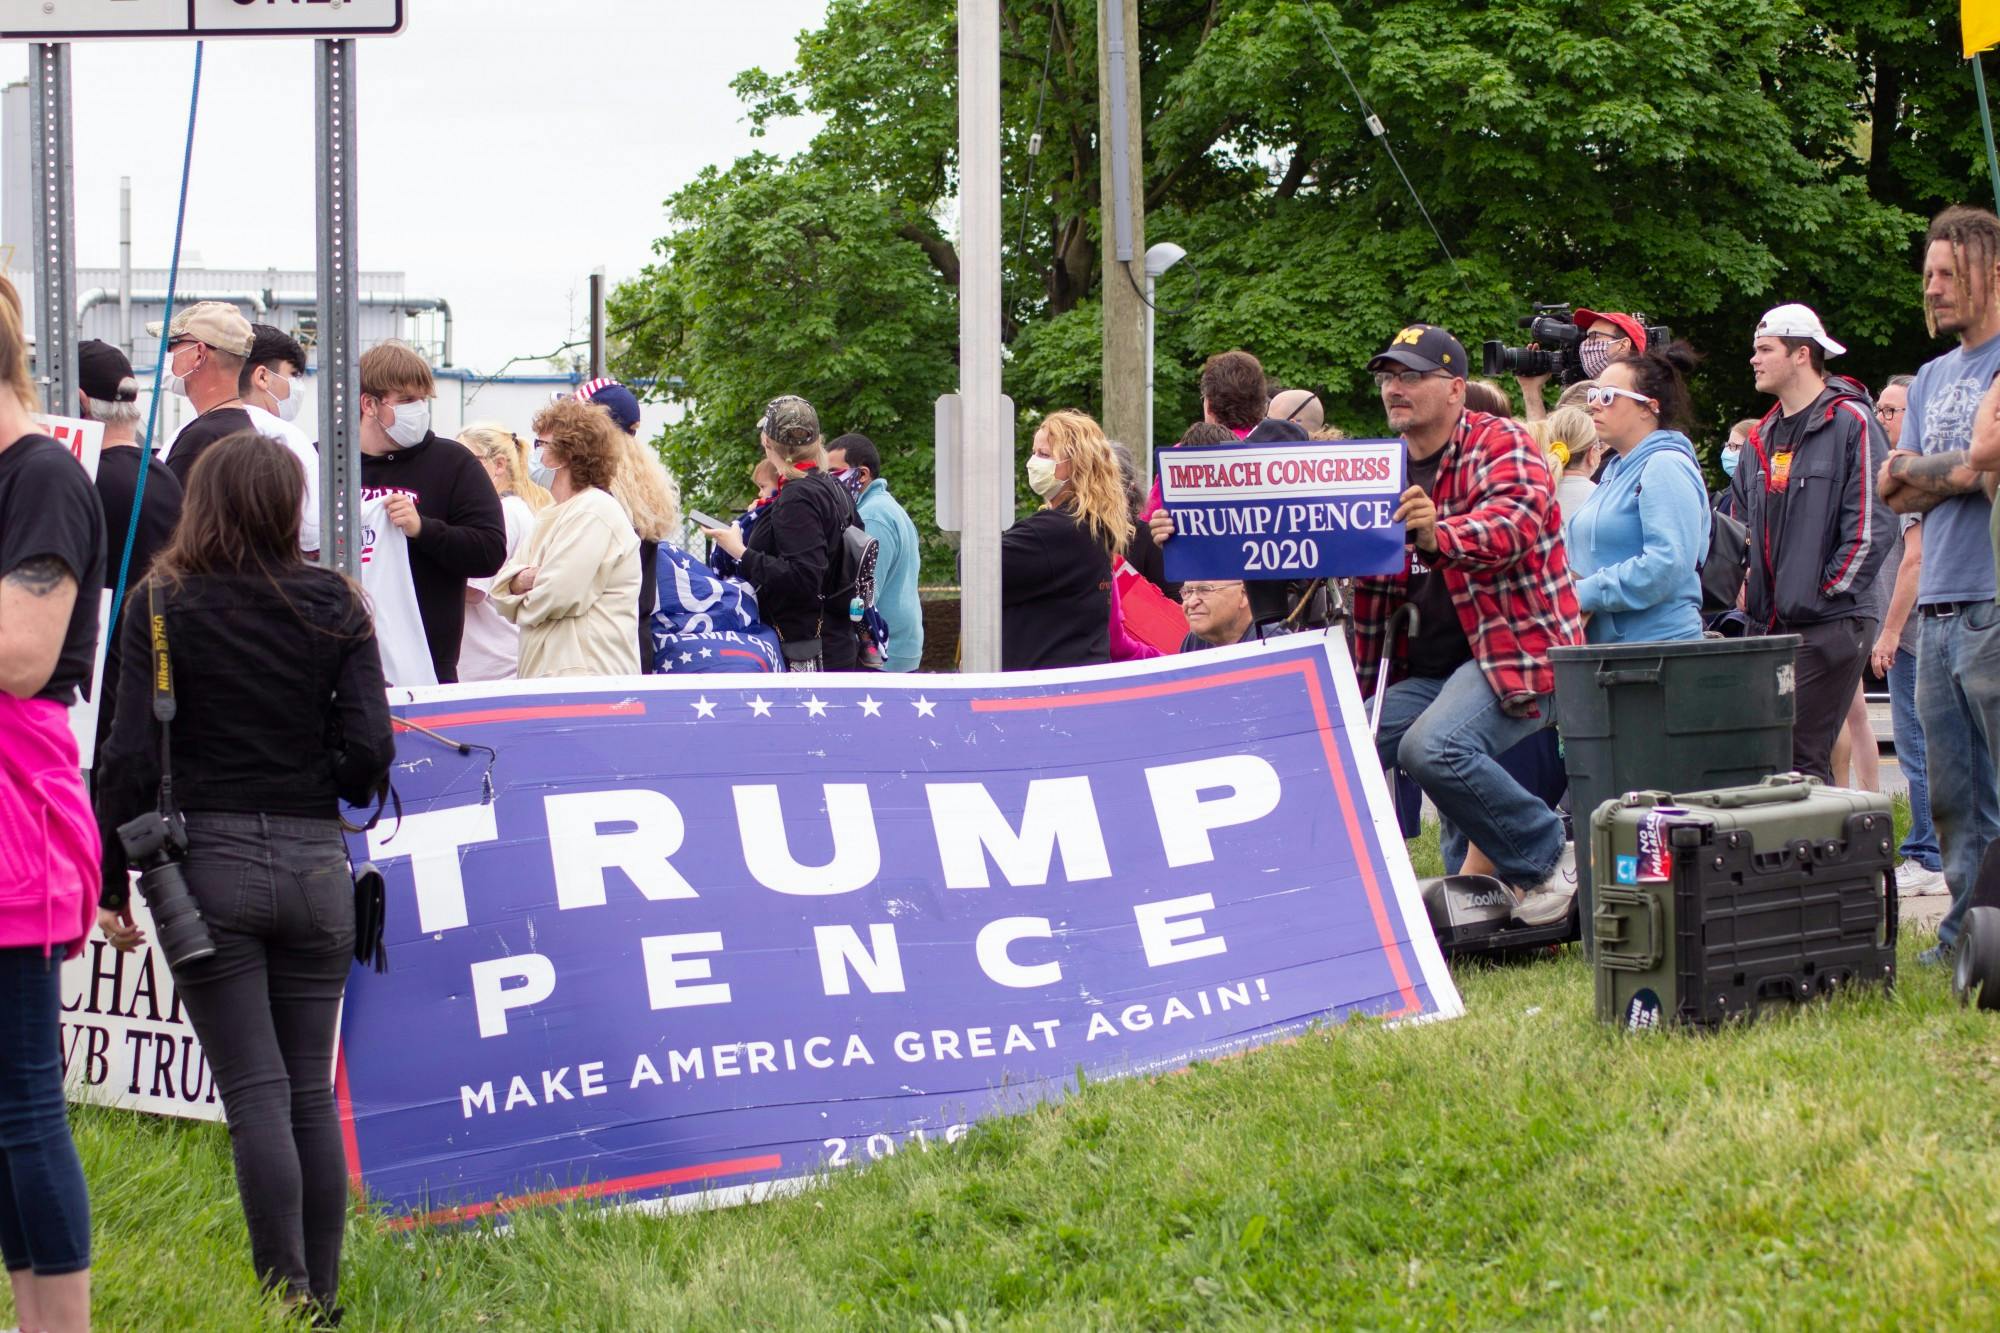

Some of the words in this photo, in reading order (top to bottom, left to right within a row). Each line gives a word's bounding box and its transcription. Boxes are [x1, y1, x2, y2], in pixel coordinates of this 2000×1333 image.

[1392, 328, 1424, 346] M
[1168, 461, 1263, 489] IMPEACH
[1267, 456, 1391, 486] CONGRESS
[1171, 501, 1393, 537] TRUMP/PENCE
[1242, 538, 1319, 571] 2020
[157, 652, 169, 691] Nikon
[366, 754, 1282, 934] TRUMP
[1639, 830, 1652, 854] NO
[470, 892, 1228, 1039] PENCE
[125, 1028, 216, 1104] TRU
[459, 1060, 608, 1119] MAKE
[629, 1033, 875, 1089] AMERICA
[893, 1019, 1062, 1063] GREAT
[1086, 977, 1271, 1042] AGAIN!
